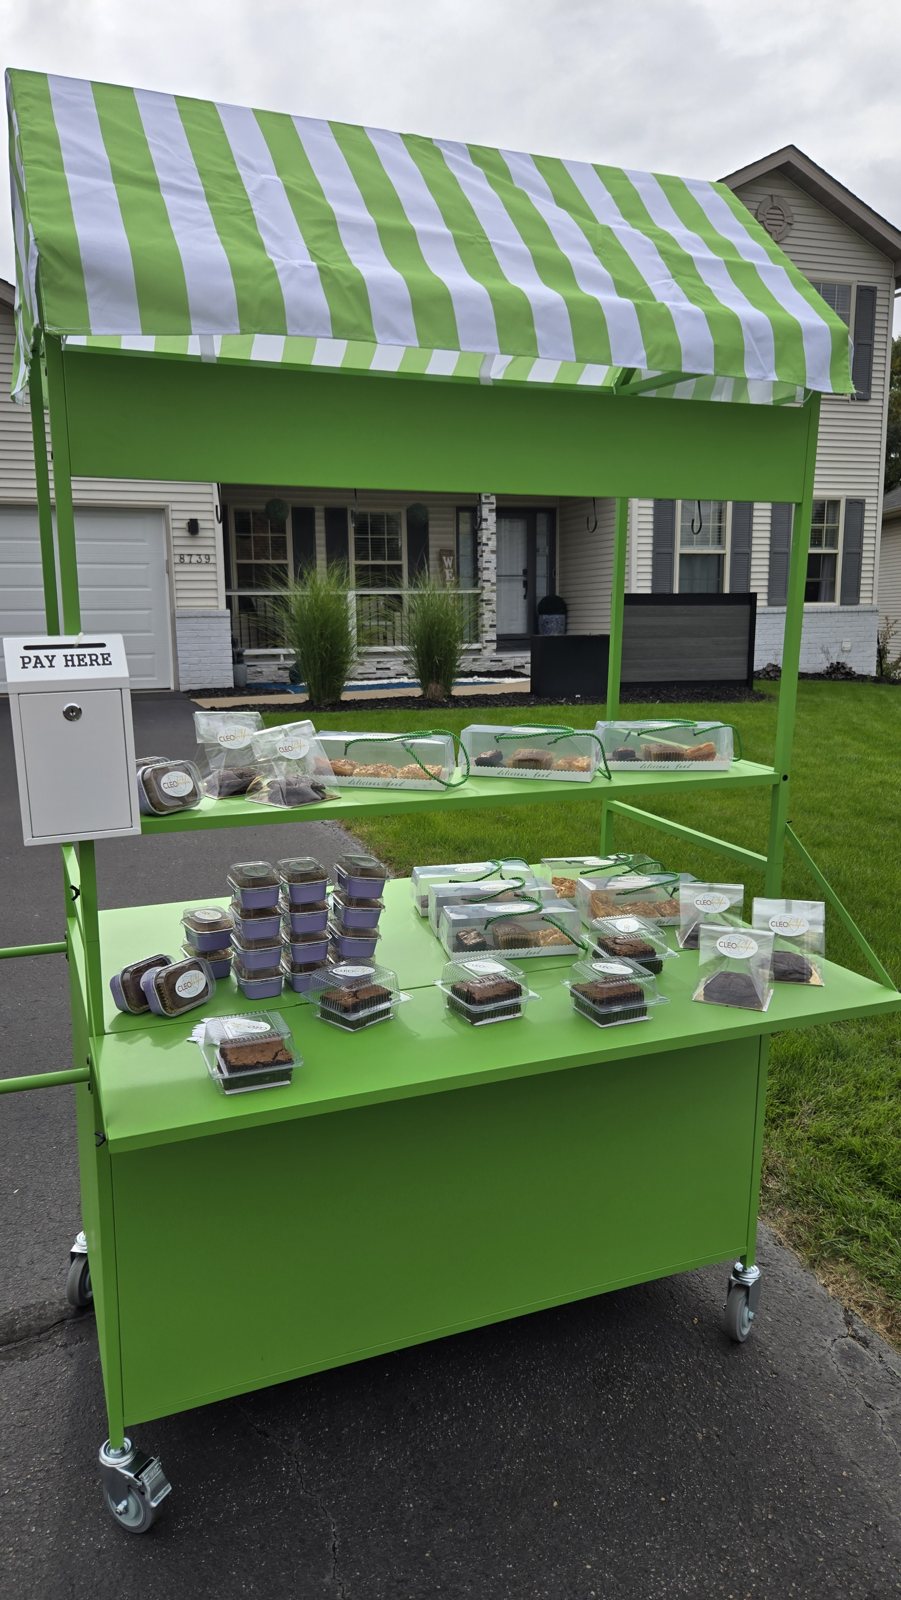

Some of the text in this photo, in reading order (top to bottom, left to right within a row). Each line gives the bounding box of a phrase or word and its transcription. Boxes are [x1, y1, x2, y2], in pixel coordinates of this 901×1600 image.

[179, 554, 211, 564] 8739
[20, 653, 112, 669] PAY HERE
[219, 734, 236, 743] CLEO
[162, 780, 179, 790] CLEO
[770, 920, 789, 928] CLEO
[718, 940, 738, 950] CLEO
[177, 981, 192, 993] CLEO
